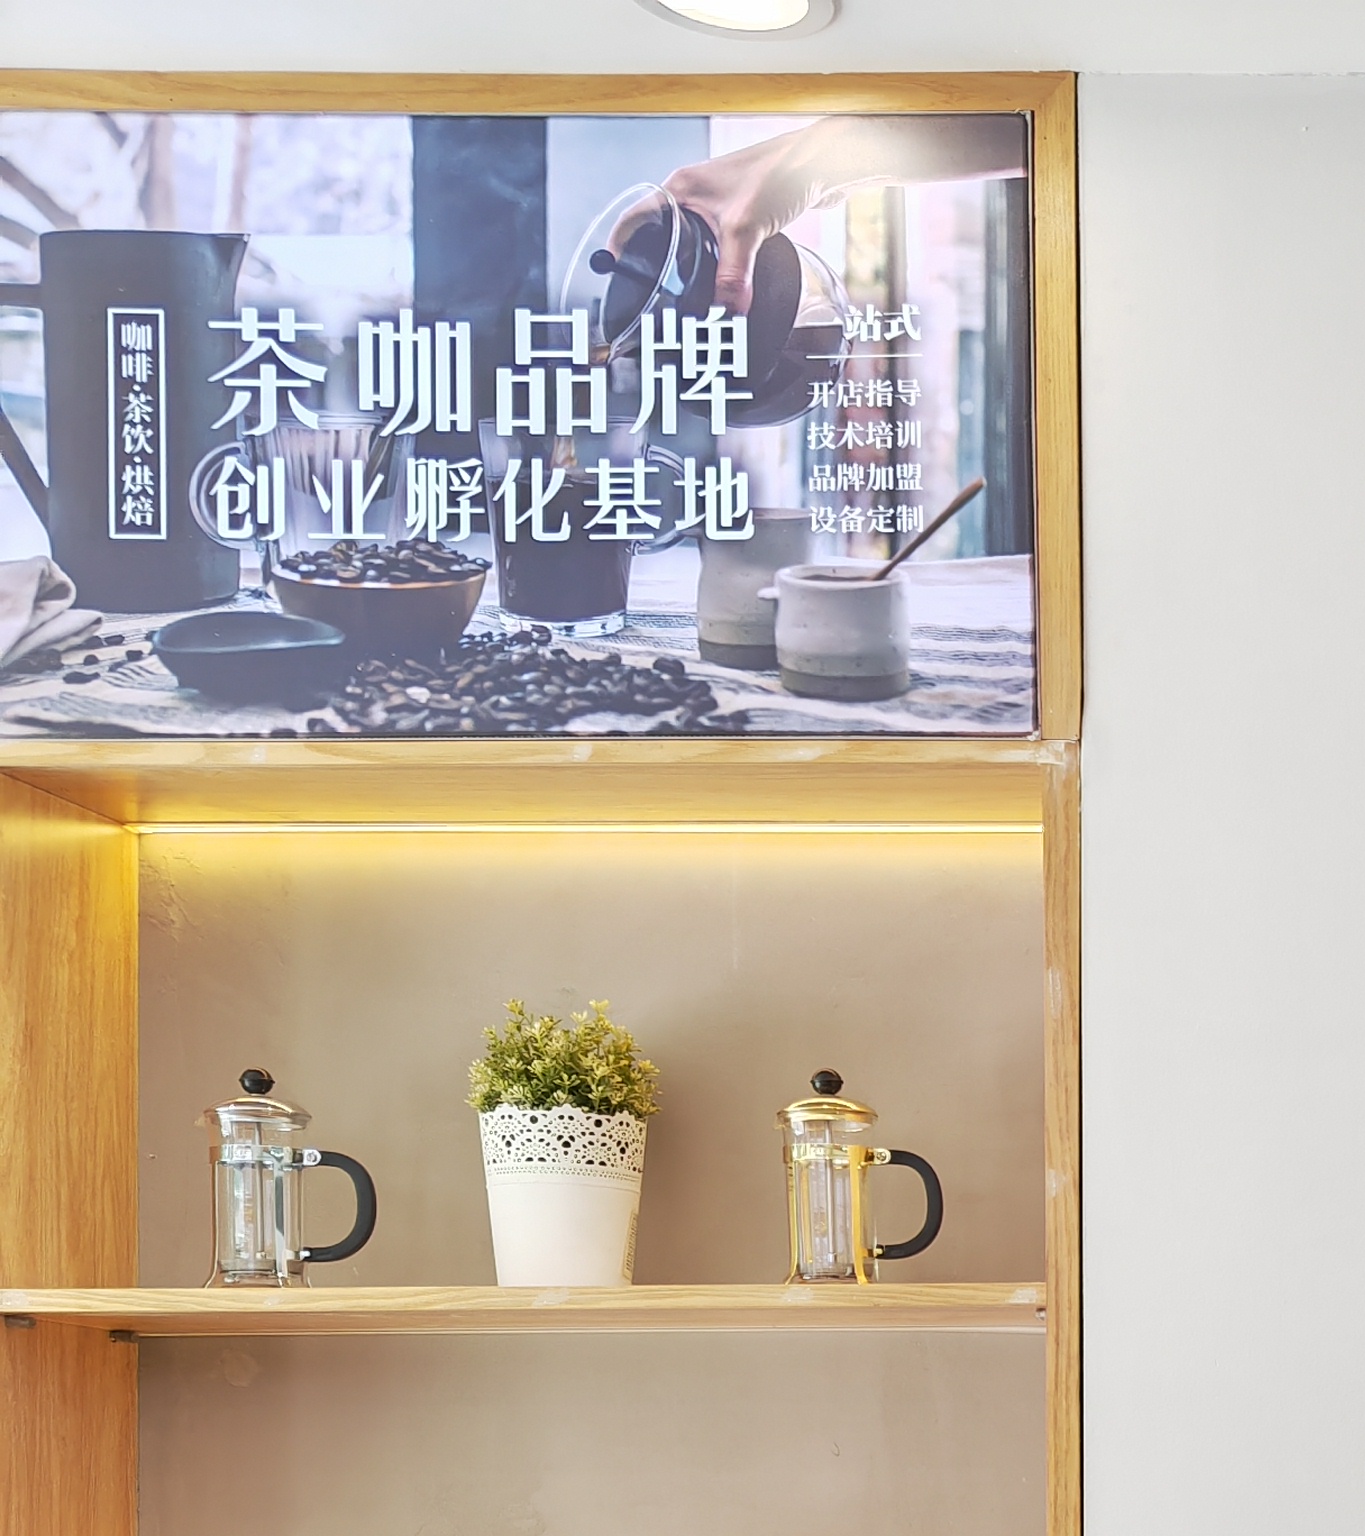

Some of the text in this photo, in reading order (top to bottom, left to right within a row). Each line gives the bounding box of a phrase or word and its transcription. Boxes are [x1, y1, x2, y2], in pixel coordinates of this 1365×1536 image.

[805, 303, 923, 342] 一站式
[206, 306, 754, 437] 茶咖品牌
[806, 378, 923, 409] 开店指导
[120, 320, 155, 527] 咖啡·茶饮·烘焙
[806, 420, 923, 451] 技术培训
[808, 462, 924, 493] 品牌加盟
[207, 454, 755, 545] 创业孵化基地
[808, 504, 925, 534] 设备定制
